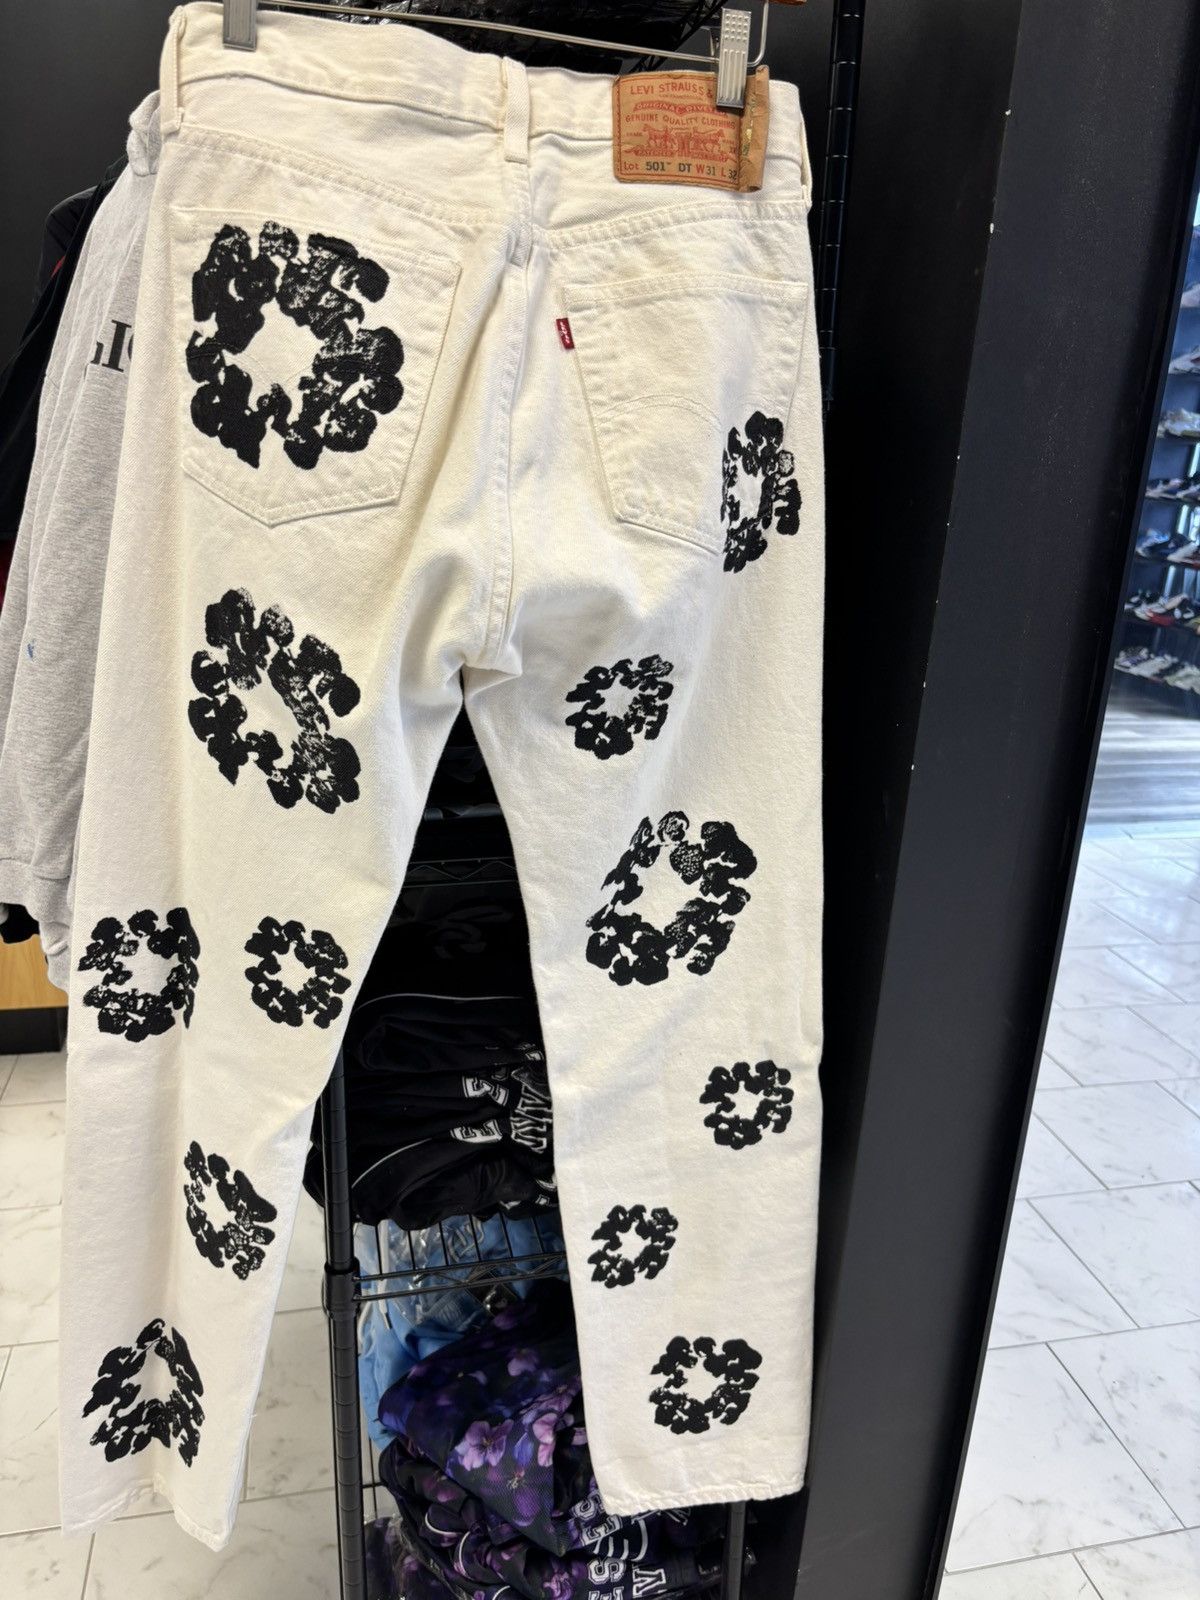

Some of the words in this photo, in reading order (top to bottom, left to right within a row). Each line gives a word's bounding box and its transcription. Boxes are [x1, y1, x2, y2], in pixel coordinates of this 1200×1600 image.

[630, 85, 654, 95] LEVI
[659, 82, 705, 96] STRAUSS
[706, 88, 714, 99] &
[625, 113, 659, 123] GENUINE
[662, 115, 699, 126] QUALITY
[701, 117, 736, 130] CLOTHING
[623, 161, 640, 171] Lot
[678, 162, 693, 173] DT
